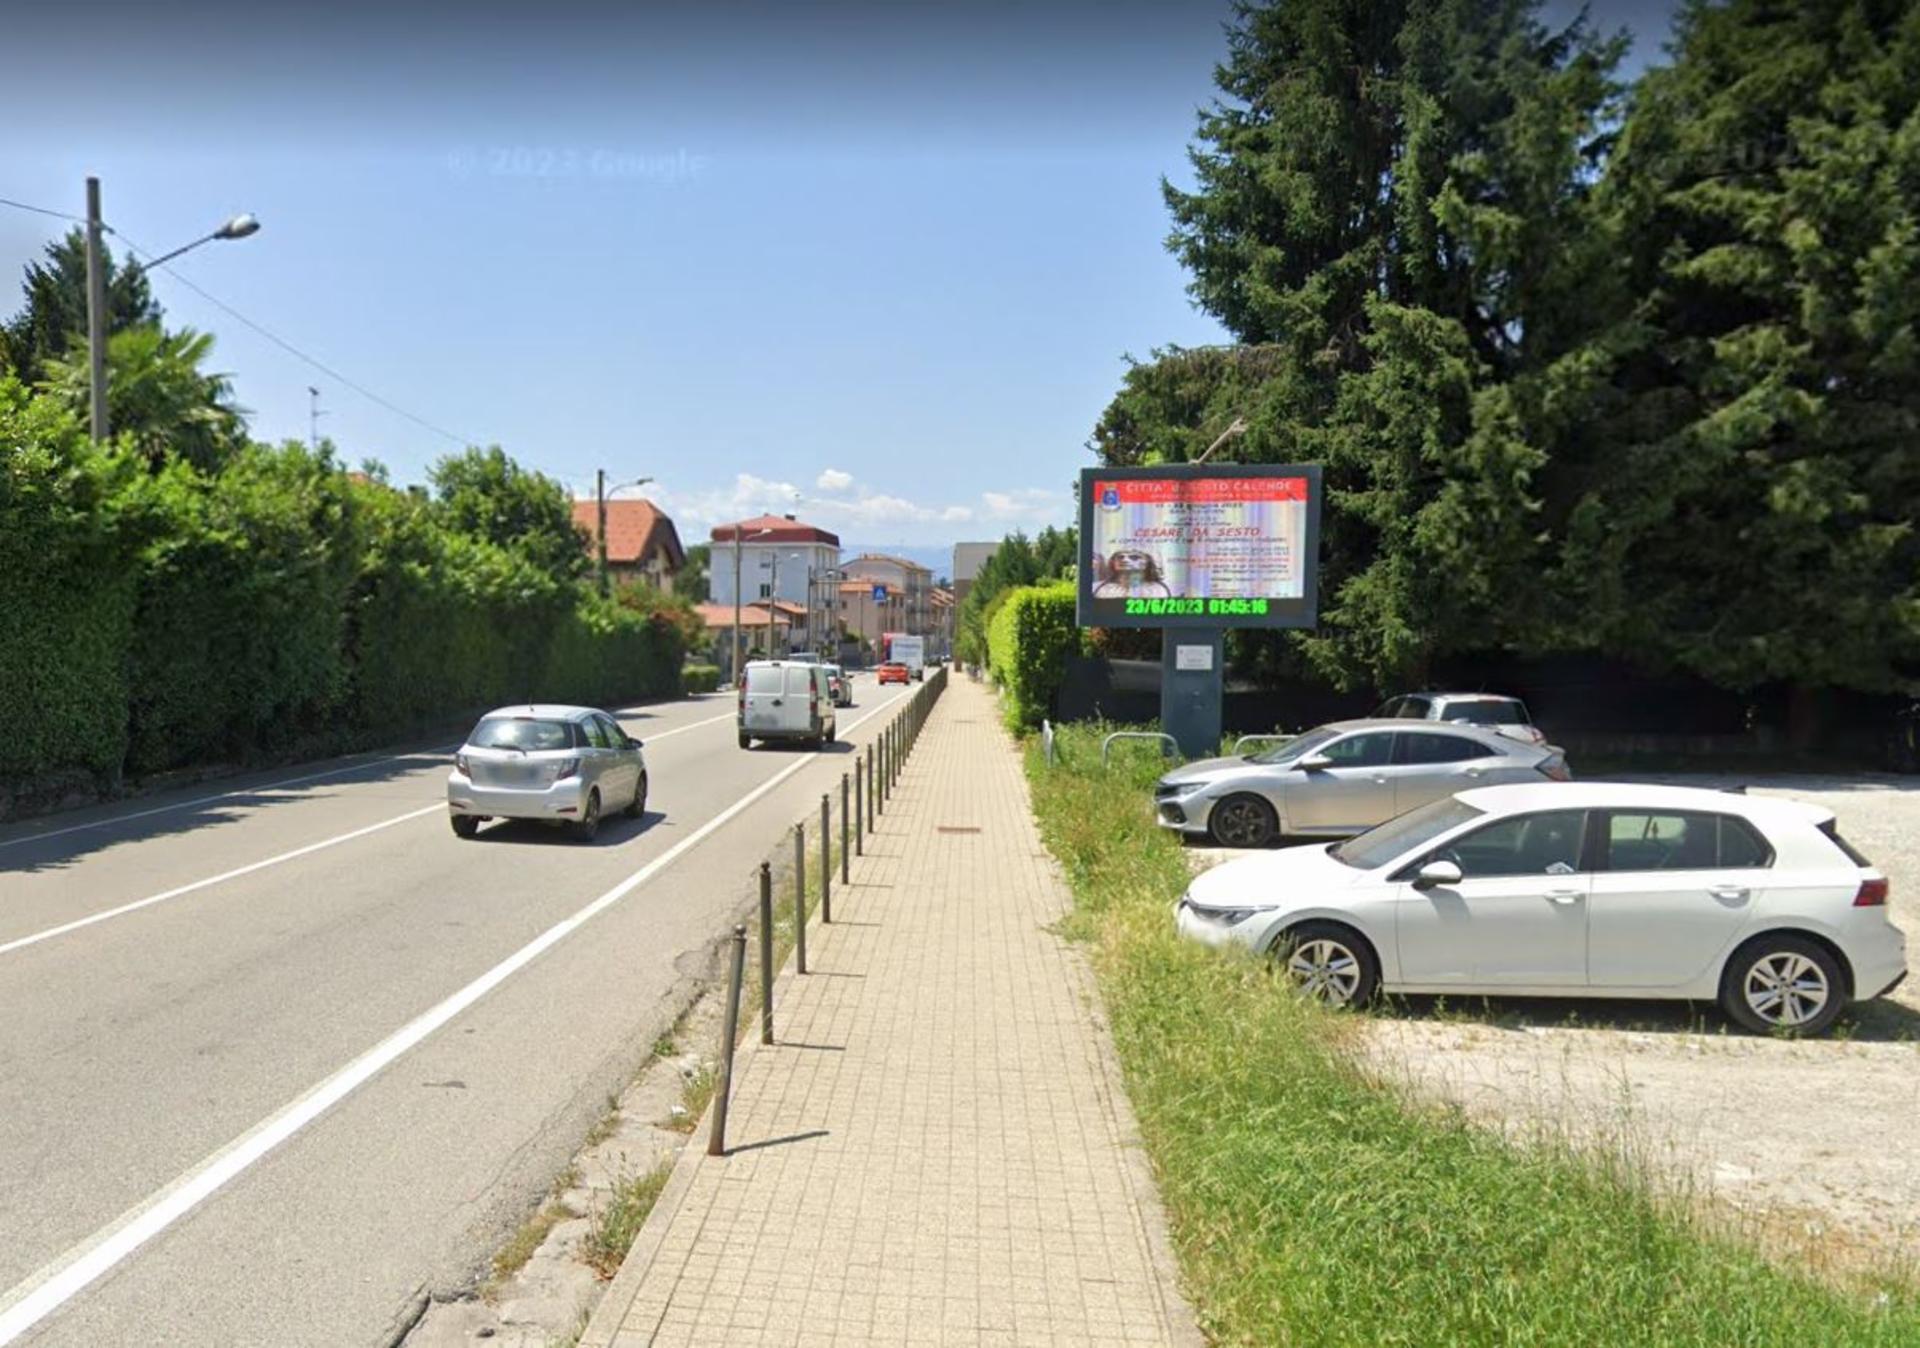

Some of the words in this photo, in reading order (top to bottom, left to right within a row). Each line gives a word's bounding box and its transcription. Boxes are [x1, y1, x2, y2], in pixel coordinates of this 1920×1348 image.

[1135, 527, 1184, 537] CESARE
[1192, 527, 1209, 537] DA
[1217, 527, 1261, 537] SESTO
[1126, 599, 1204, 614] 23/6/2023
[1209, 599, 1268, 614] 01:45:16
